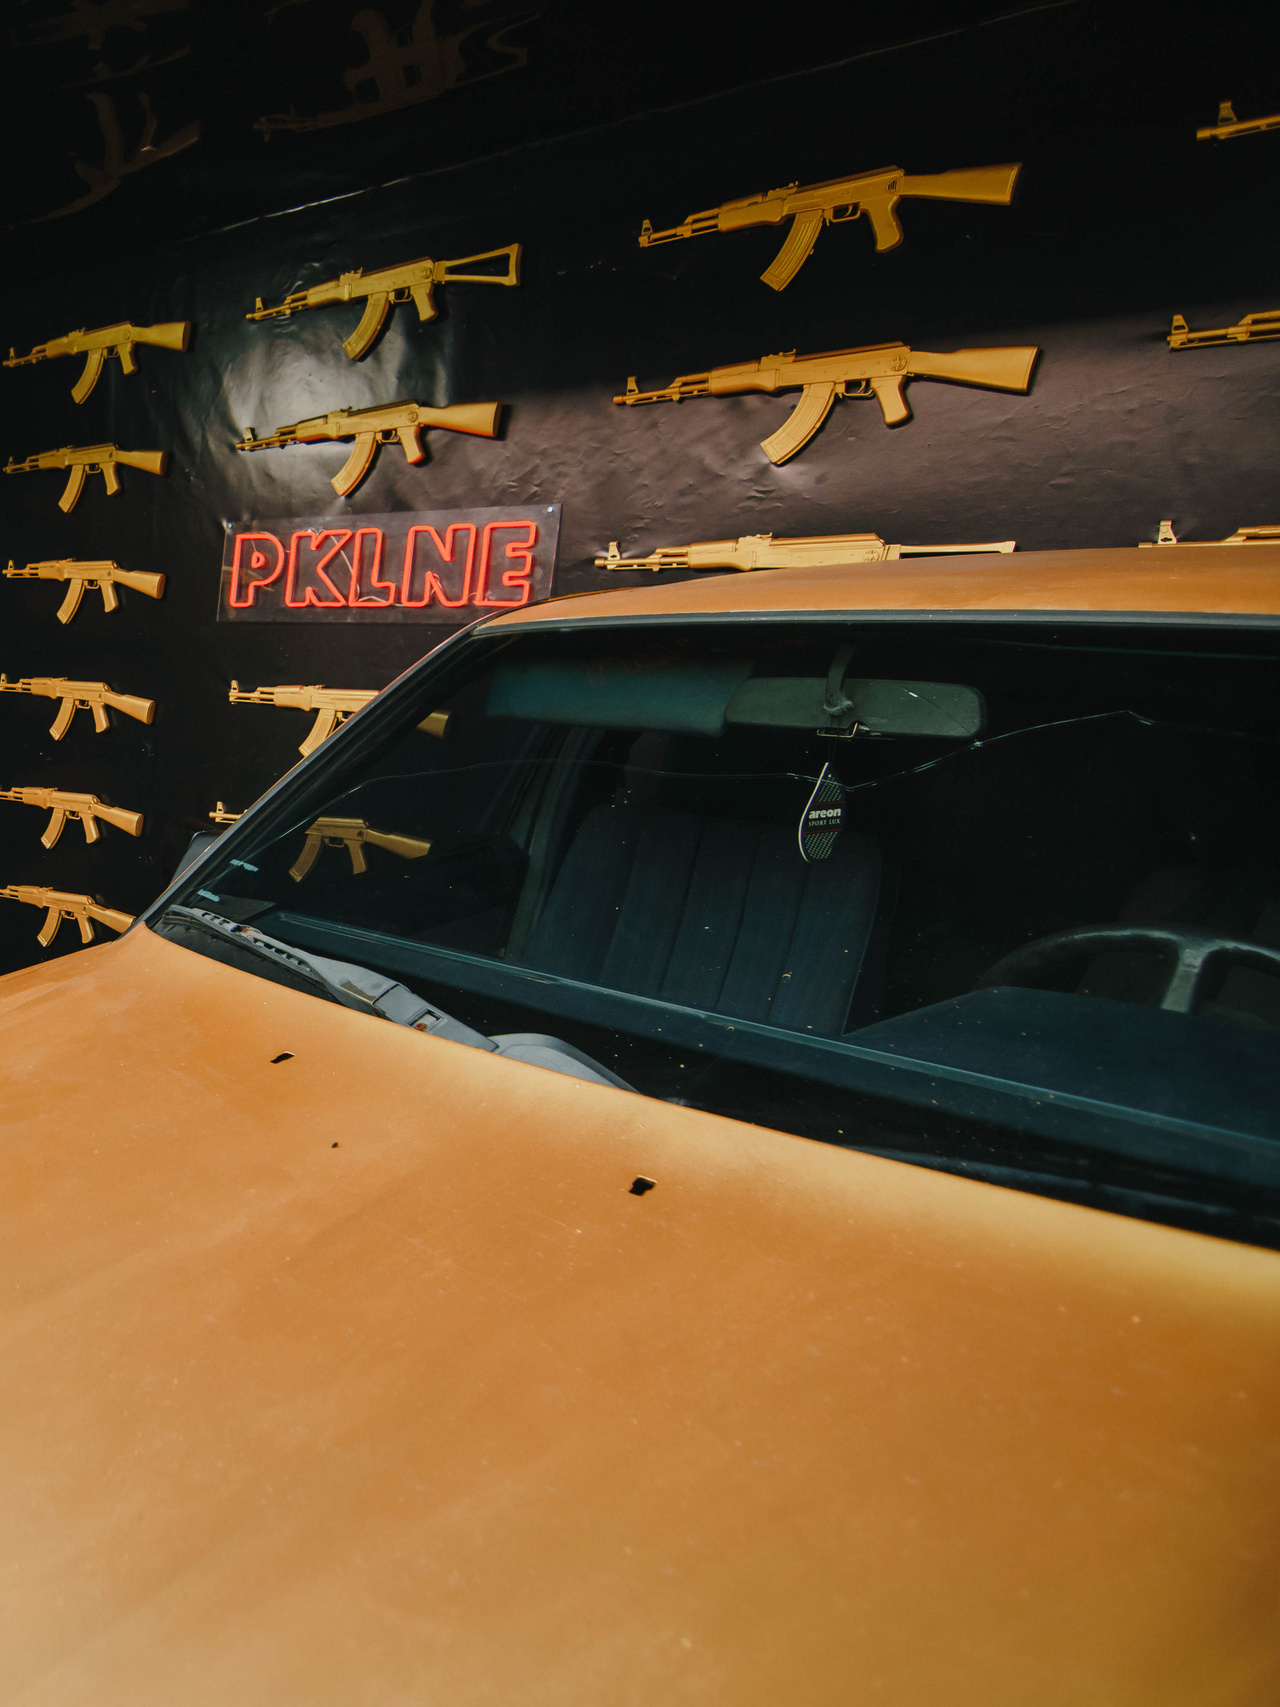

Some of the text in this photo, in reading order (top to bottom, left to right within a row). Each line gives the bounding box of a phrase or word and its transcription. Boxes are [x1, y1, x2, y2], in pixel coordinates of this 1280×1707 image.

[229, 519, 537, 607] PKLNE
[808, 808, 842, 819] areon
[808, 819, 827, 827] SPORT
